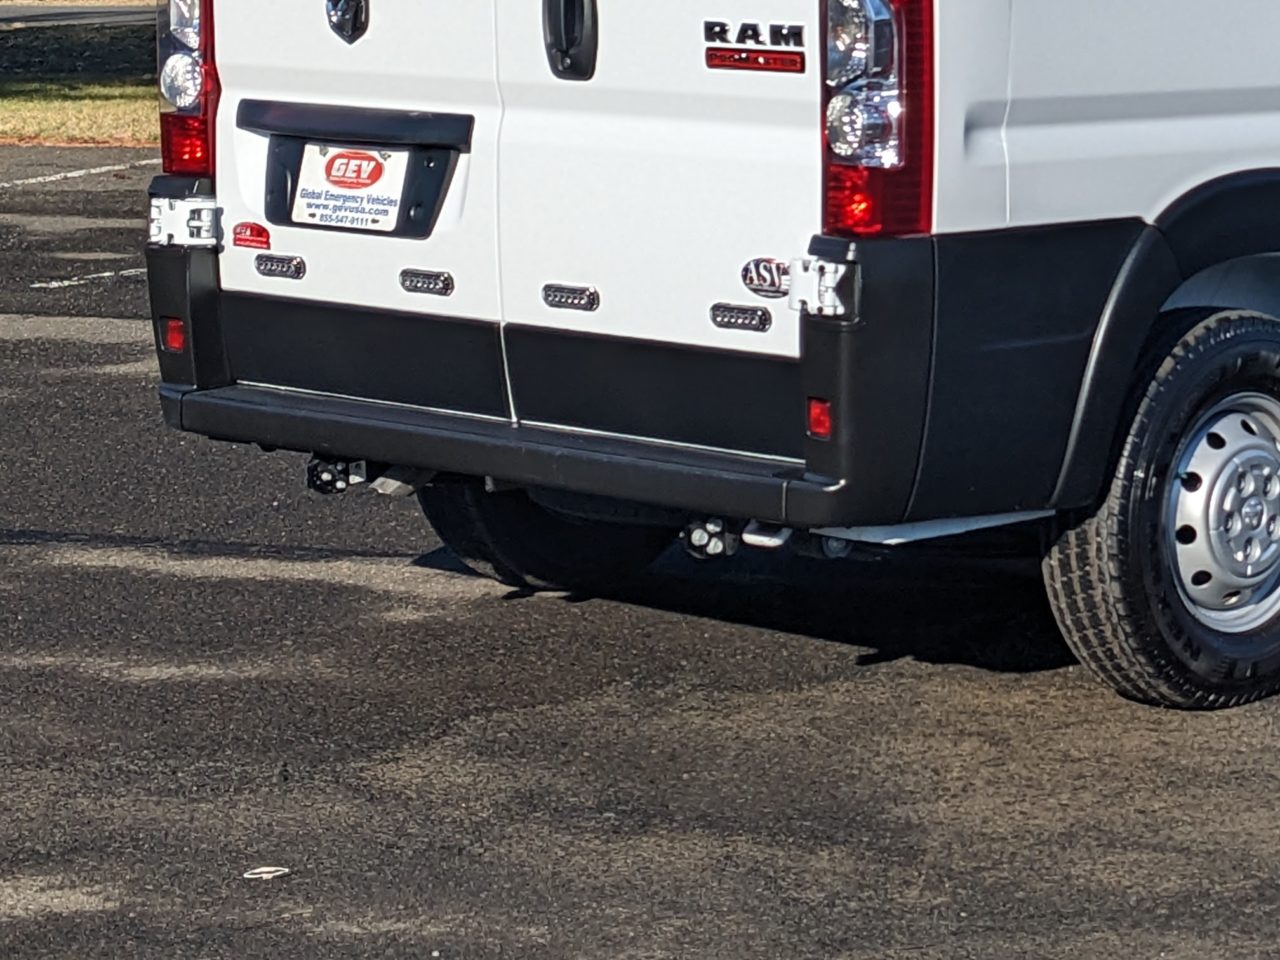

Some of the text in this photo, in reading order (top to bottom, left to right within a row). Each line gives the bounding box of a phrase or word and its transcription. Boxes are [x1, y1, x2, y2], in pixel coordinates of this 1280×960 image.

[704, 20, 805, 47] RAM
[330, 158, 376, 179] GEV
[300, 188, 398, 208] Global Emergency Vehicles
